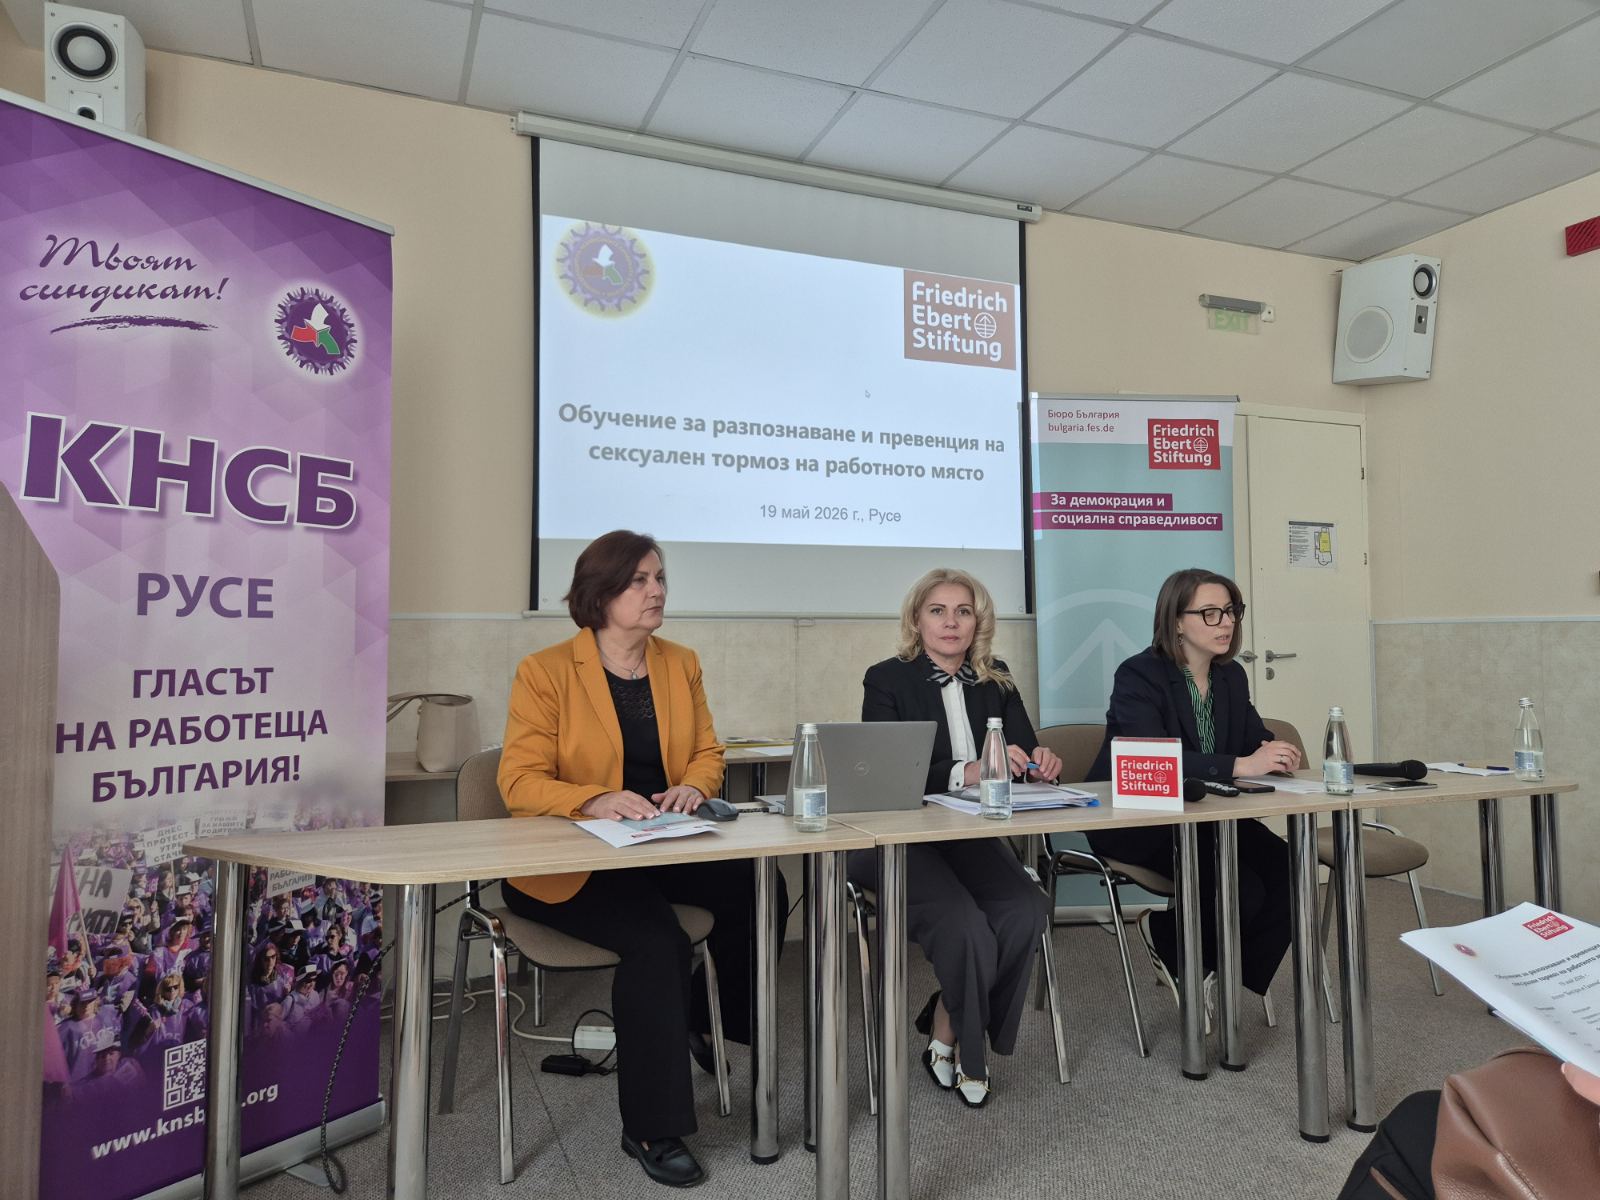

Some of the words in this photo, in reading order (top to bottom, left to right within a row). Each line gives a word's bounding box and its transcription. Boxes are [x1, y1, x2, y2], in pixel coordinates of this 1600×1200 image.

[39, 234, 197, 271] Твоят
[19, 277, 230, 312] синдикат!
[912, 281, 1007, 313] Friedrich
[912, 304, 972, 331] Ebert
[912, 328, 1002, 362] Stiftung
[558, 403, 677, 429] Обучение
[682, 417, 706, 432] за
[713, 419, 856, 442] разпознаване
[861, 430, 873, 443] и
[879, 431, 979, 453] превенция
[985, 439, 1005, 452] на
[1047, 408, 1074, 420] Бюро
[1076, 410, 1120, 421] България
[1048, 423, 1115, 435] bulgaria.fes.de
[1152, 424, 1215, 437] Friedrich
[1153, 437, 1192, 450] Ebert
[20, 411, 357, 530] КНСБ
[588, 445, 705, 468] сексуален
[711, 452, 789, 473] тормоз
[796, 458, 819, 472] на
[825, 457, 926, 478] работното
[931, 465, 984, 481] място
[1153, 451, 1212, 466] Stiftung
[760, 504, 777, 518] 19
[781, 506, 810, 520] май
[814, 507, 848, 521] 2026
[869, 508, 902, 525] Русе
[1050, 493, 1066, 506] За
[1069, 495, 1153, 509] демокрация
[1157, 496, 1165, 506] и
[1051, 513, 1115, 525] социална
[1118, 514, 1218, 527] справедливост
[137, 572, 274, 619] РУСЕ
[133, 667, 274, 698] ГЛАСЪТ
[55, 720, 116, 754] НА
[129, 709, 328, 748] РАБОТЕЩА
[92, 754, 301, 802] БЪЛГАРИЯ!
[1120, 760, 1173, 771] Friedrich
[1121, 770, 1153, 780] Ebert
[1121, 780, 1170, 794] Stiftung
[92, 1084, 279, 1160] www.knsb.org
